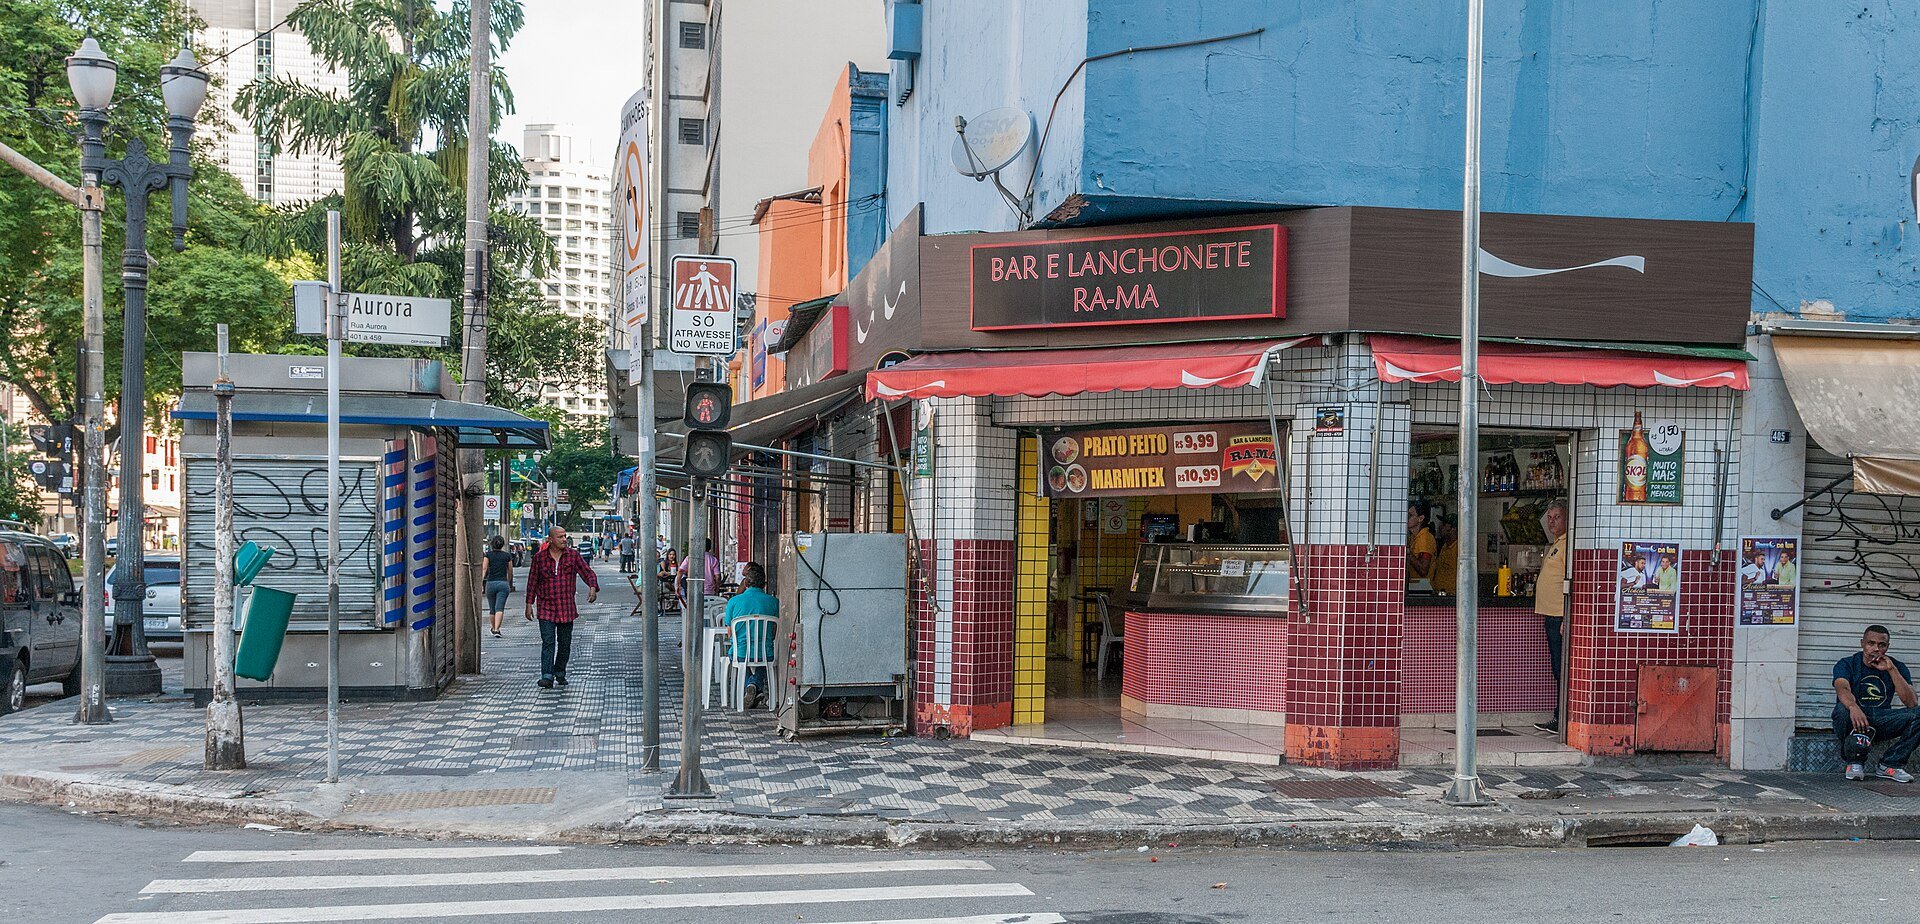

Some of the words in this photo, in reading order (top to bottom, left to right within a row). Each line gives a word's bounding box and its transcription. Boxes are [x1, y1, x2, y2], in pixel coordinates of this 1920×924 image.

[991, 255, 1039, 282] BAR
[1047, 253, 1060, 279] E
[1068, 241, 1251, 278] LANCHONETE
[1073, 283, 1159, 312] RA-MA
[352, 297, 412, 317] Aurora
[692, 312, 715, 327] SÓ
[365, 323, 387, 331] Aurora
[675, 329, 731, 339] ATRAVESSE
[676, 340, 691, 348] NO
[695, 341, 730, 349] VERDE
[1175, 441, 1184, 449] R$
[1184, 433, 1214, 450] 9,99
[1772, 431, 1786, 442] 405
[1083, 435, 1127, 457] PRATO
[1129, 433, 1167, 455] FEITO
[1230, 448, 1276, 461] RA-MA
[1625, 465, 1646, 476] SKOL
[1652, 461, 1677, 470] MUITO
[1091, 466, 1166, 489] MARMITEX
[1652, 470, 1676, 481] MAIS
[1650, 490, 1675, 498] MENOS!
[1624, 543, 1633, 551] 17
